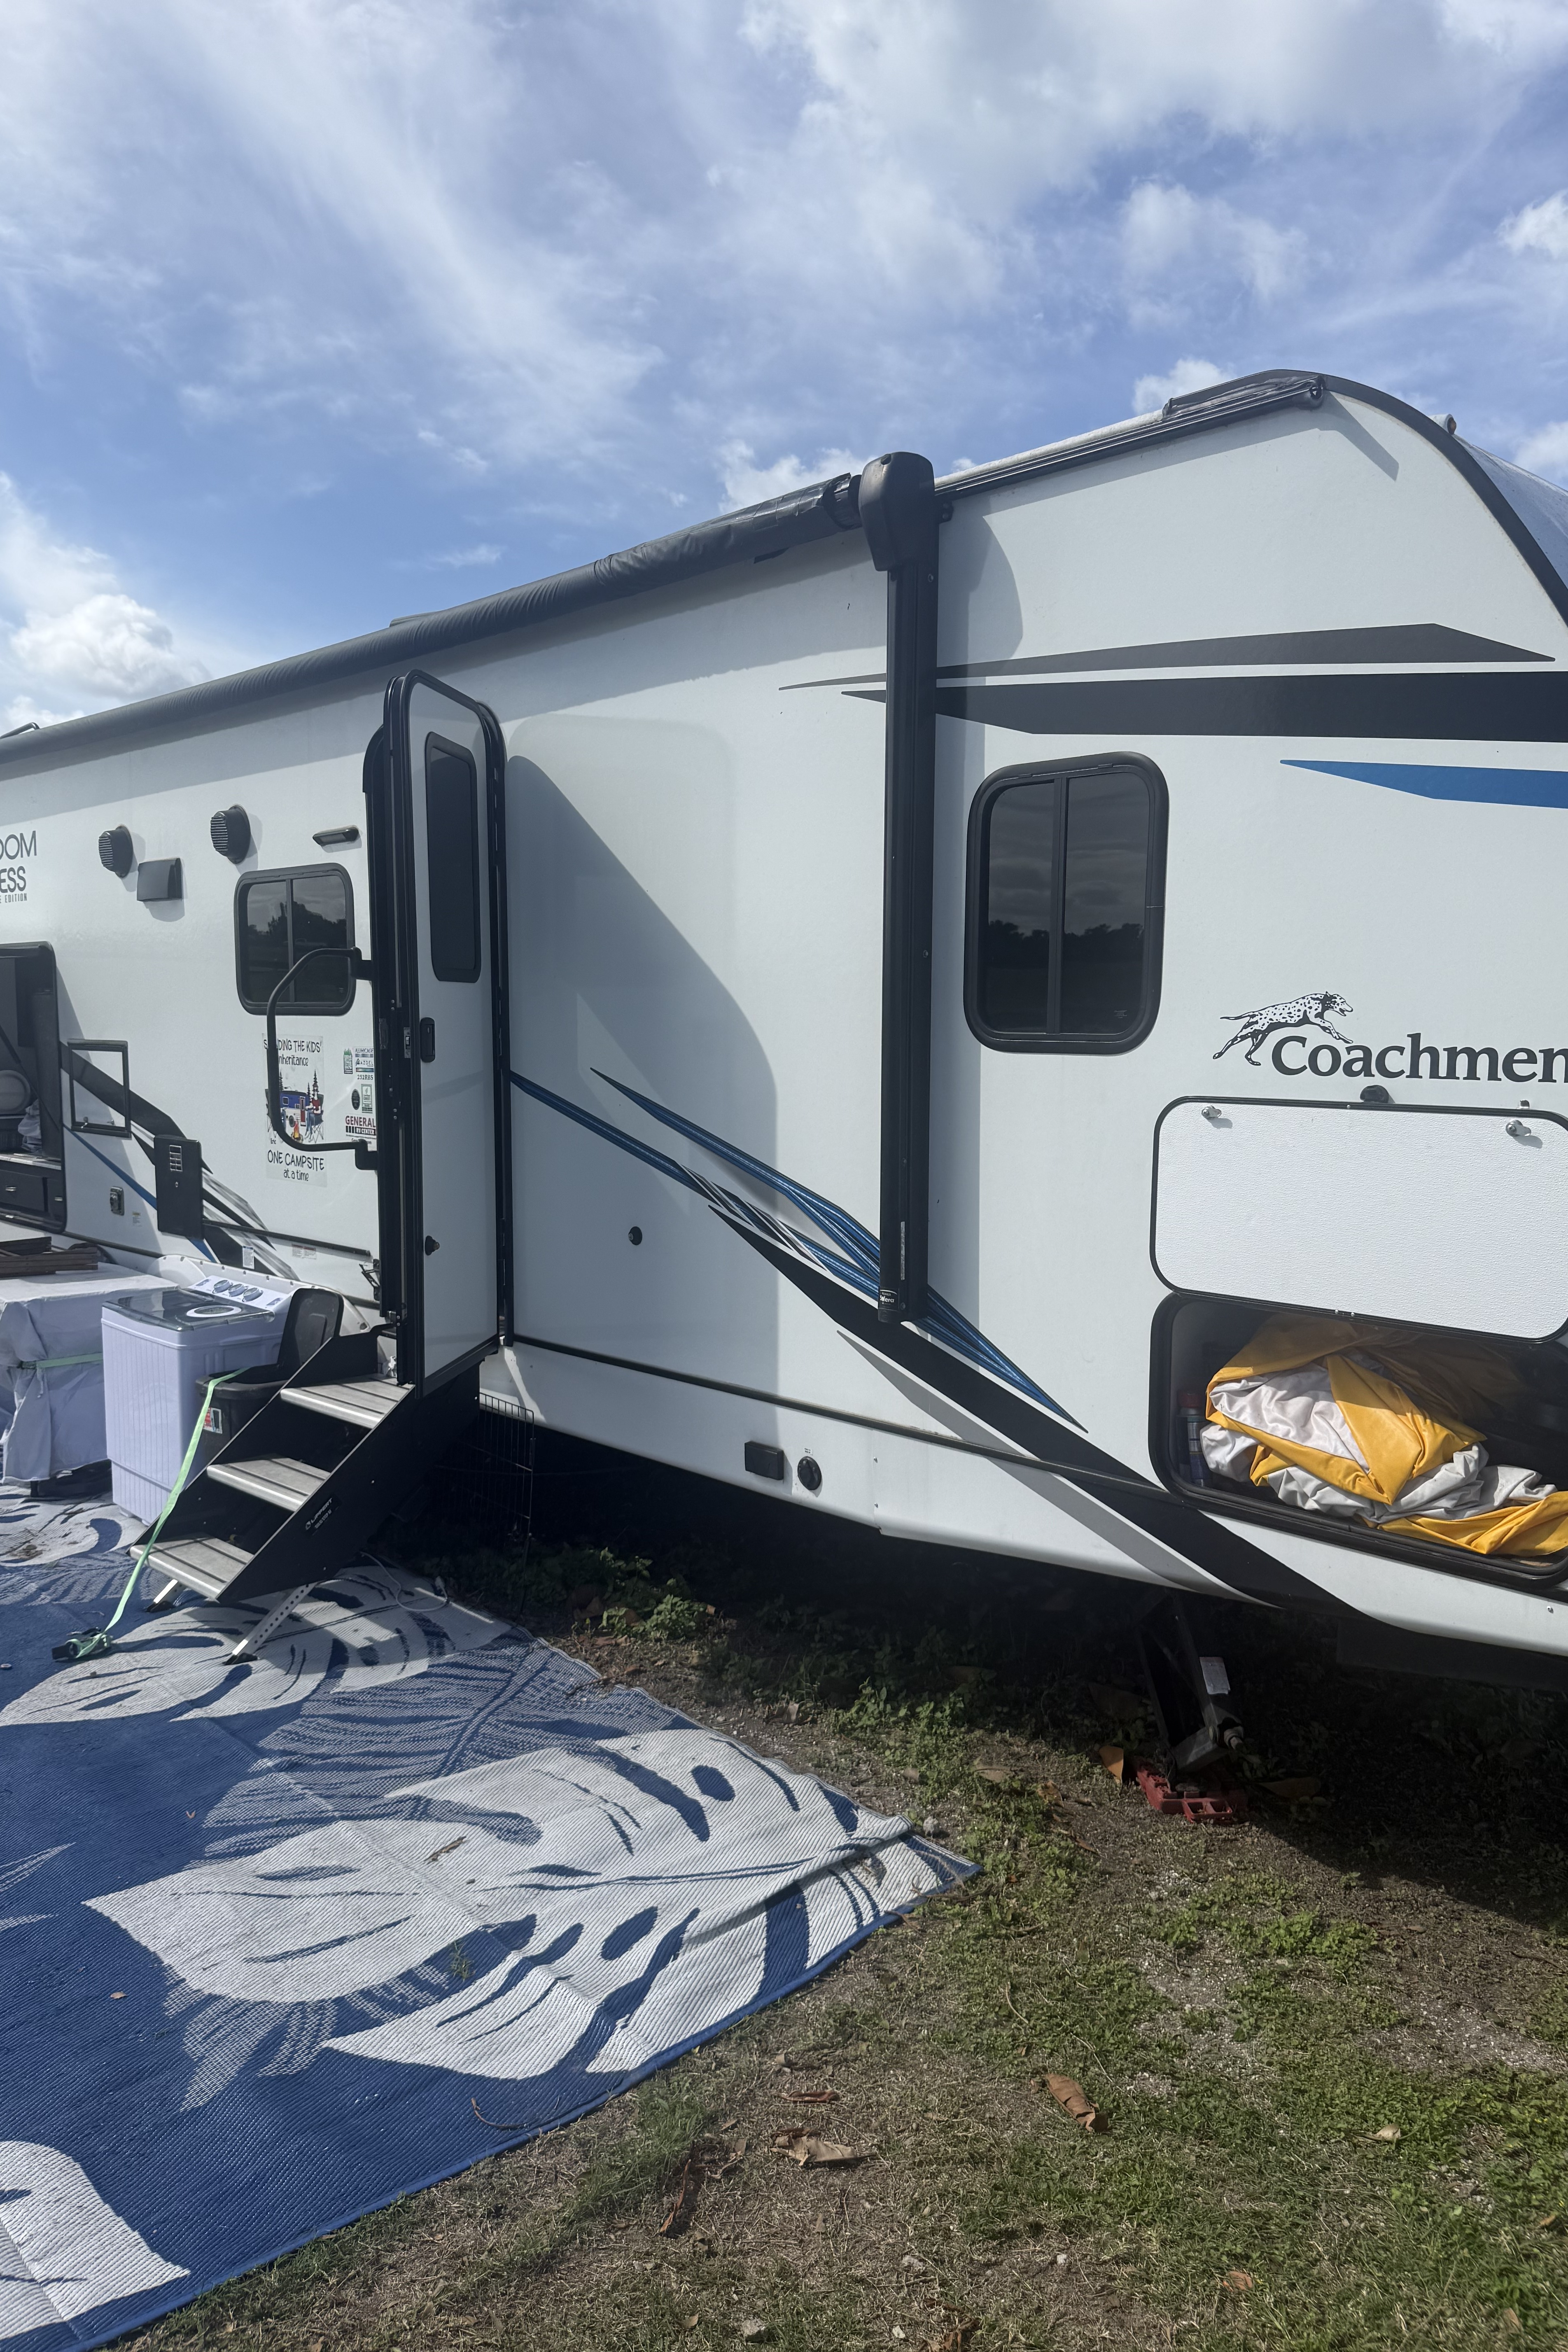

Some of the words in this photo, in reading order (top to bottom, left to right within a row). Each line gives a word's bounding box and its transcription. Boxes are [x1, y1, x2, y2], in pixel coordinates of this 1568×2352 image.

[0, 830, 37, 860] OM
[0, 866, 26, 893] ESS
[5, 893, 27, 903] EDITION
[293, 1039, 305, 1053] THE
[279, 1054, 309, 1066] nheritance
[1272, 1033, 1568, 1084] Coachmen
[345, 1115, 376, 1128] GENERAL
[268, 1150, 283, 1164] ONE
[285, 1153, 324, 1171] CAMPSITE
[284, 1168, 290, 1178] at
[291, 1171, 295, 1179] a
[296, 1170, 309, 1181] time
